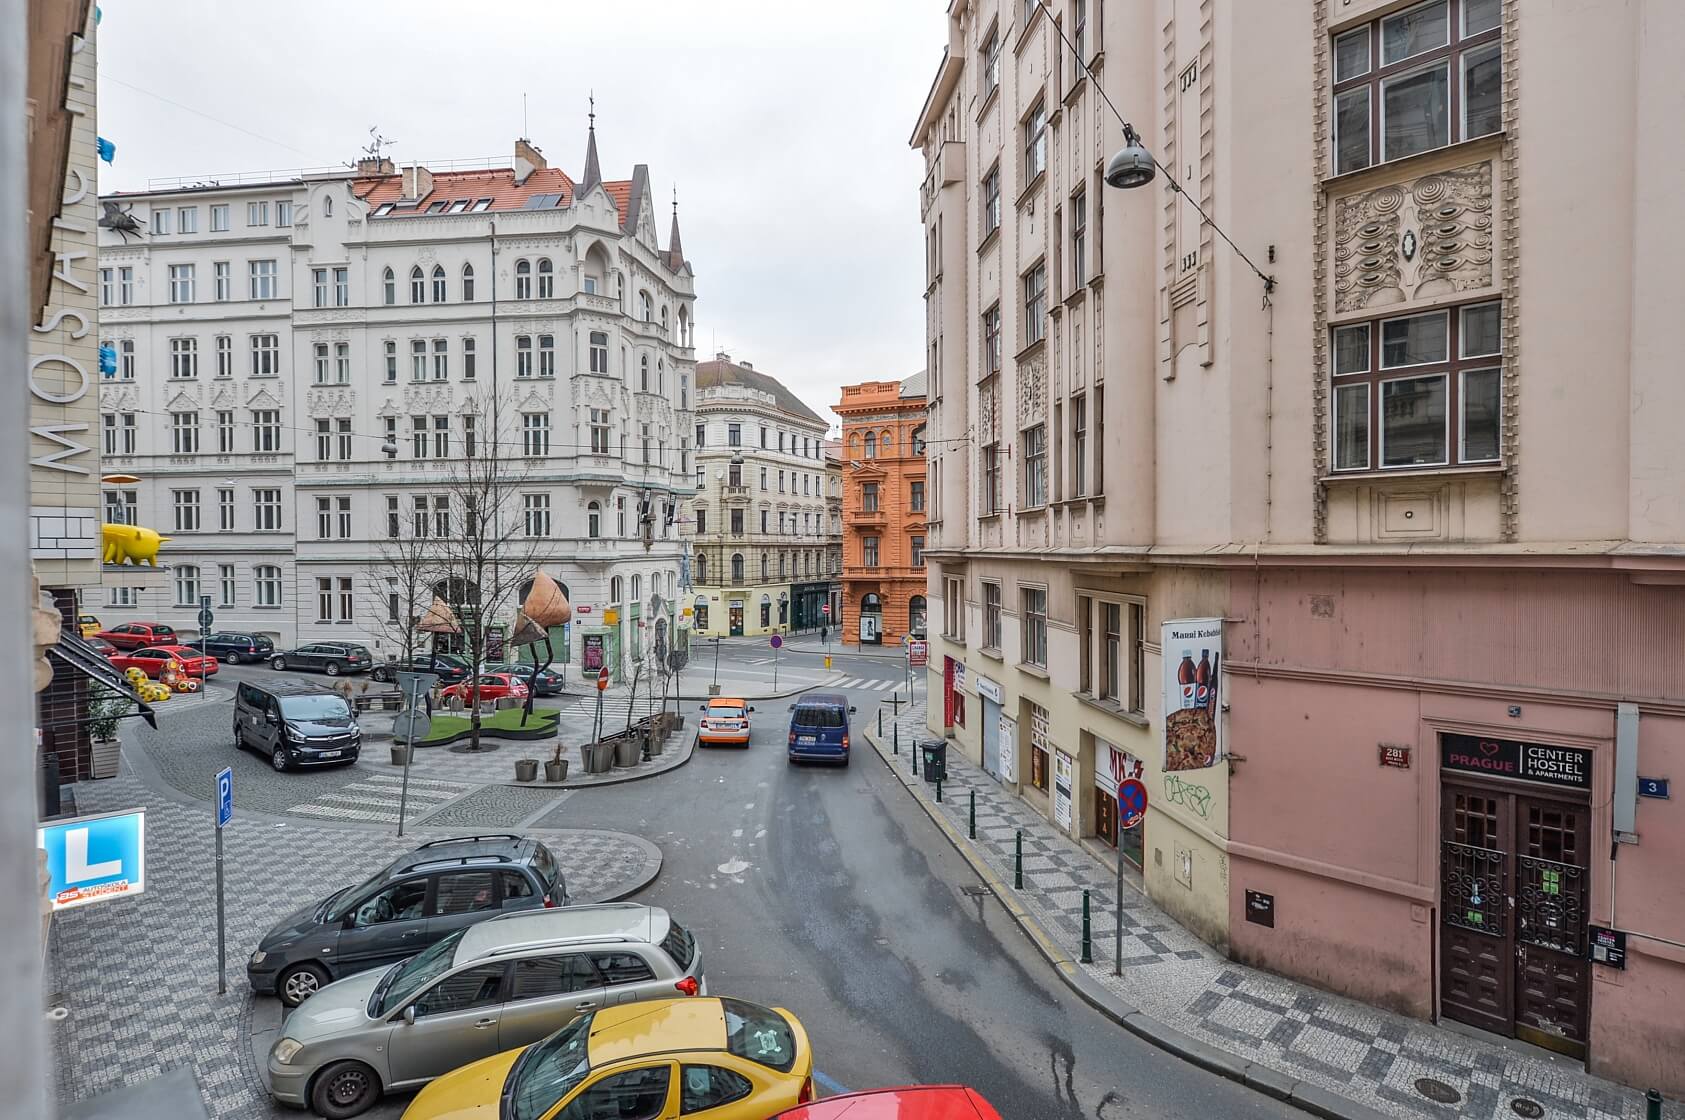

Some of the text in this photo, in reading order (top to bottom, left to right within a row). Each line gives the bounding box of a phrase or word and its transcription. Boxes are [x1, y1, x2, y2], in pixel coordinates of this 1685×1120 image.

[1386, 748, 1402, 758] 281
[1528, 748, 1583, 764] CENTER
[1450, 754, 1513, 772] PRAGUE
[1528, 758, 1583, 774] HOSTEL
[1536, 770, 1583, 782] APARTMENTS
[220, 778, 229, 810] P
[1648, 782, 1656, 792] 3
[65, 827, 122, 884] L
